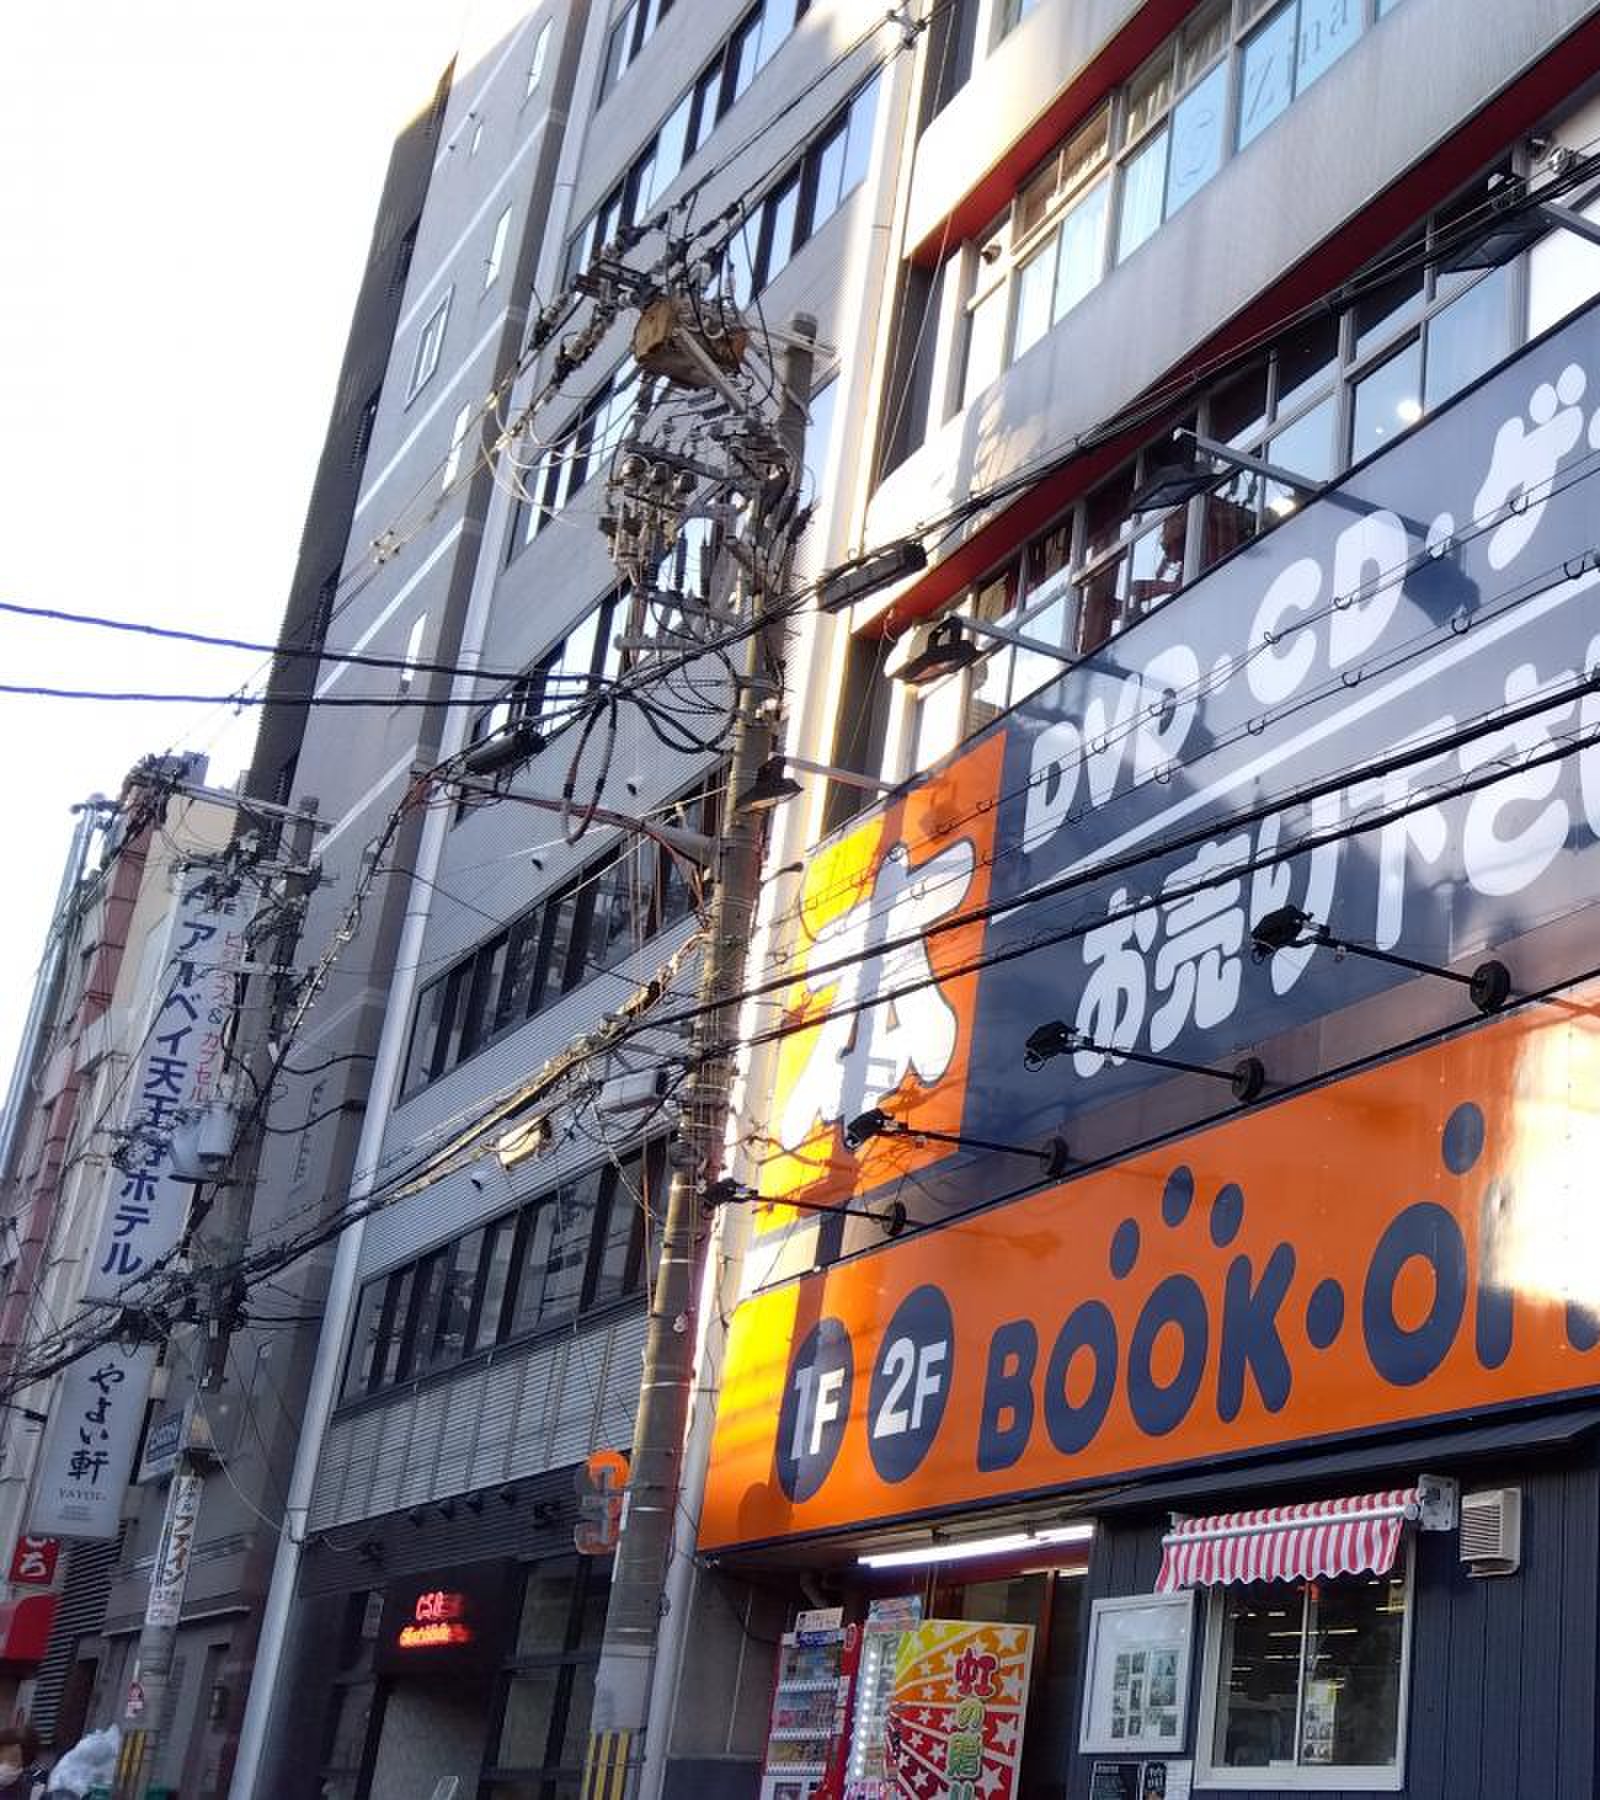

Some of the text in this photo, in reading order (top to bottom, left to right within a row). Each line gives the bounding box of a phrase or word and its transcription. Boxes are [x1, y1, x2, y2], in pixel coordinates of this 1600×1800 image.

[67, 1363, 125, 1485] やよい軒
[791, 1335, 948, 1461] 1F 2F
